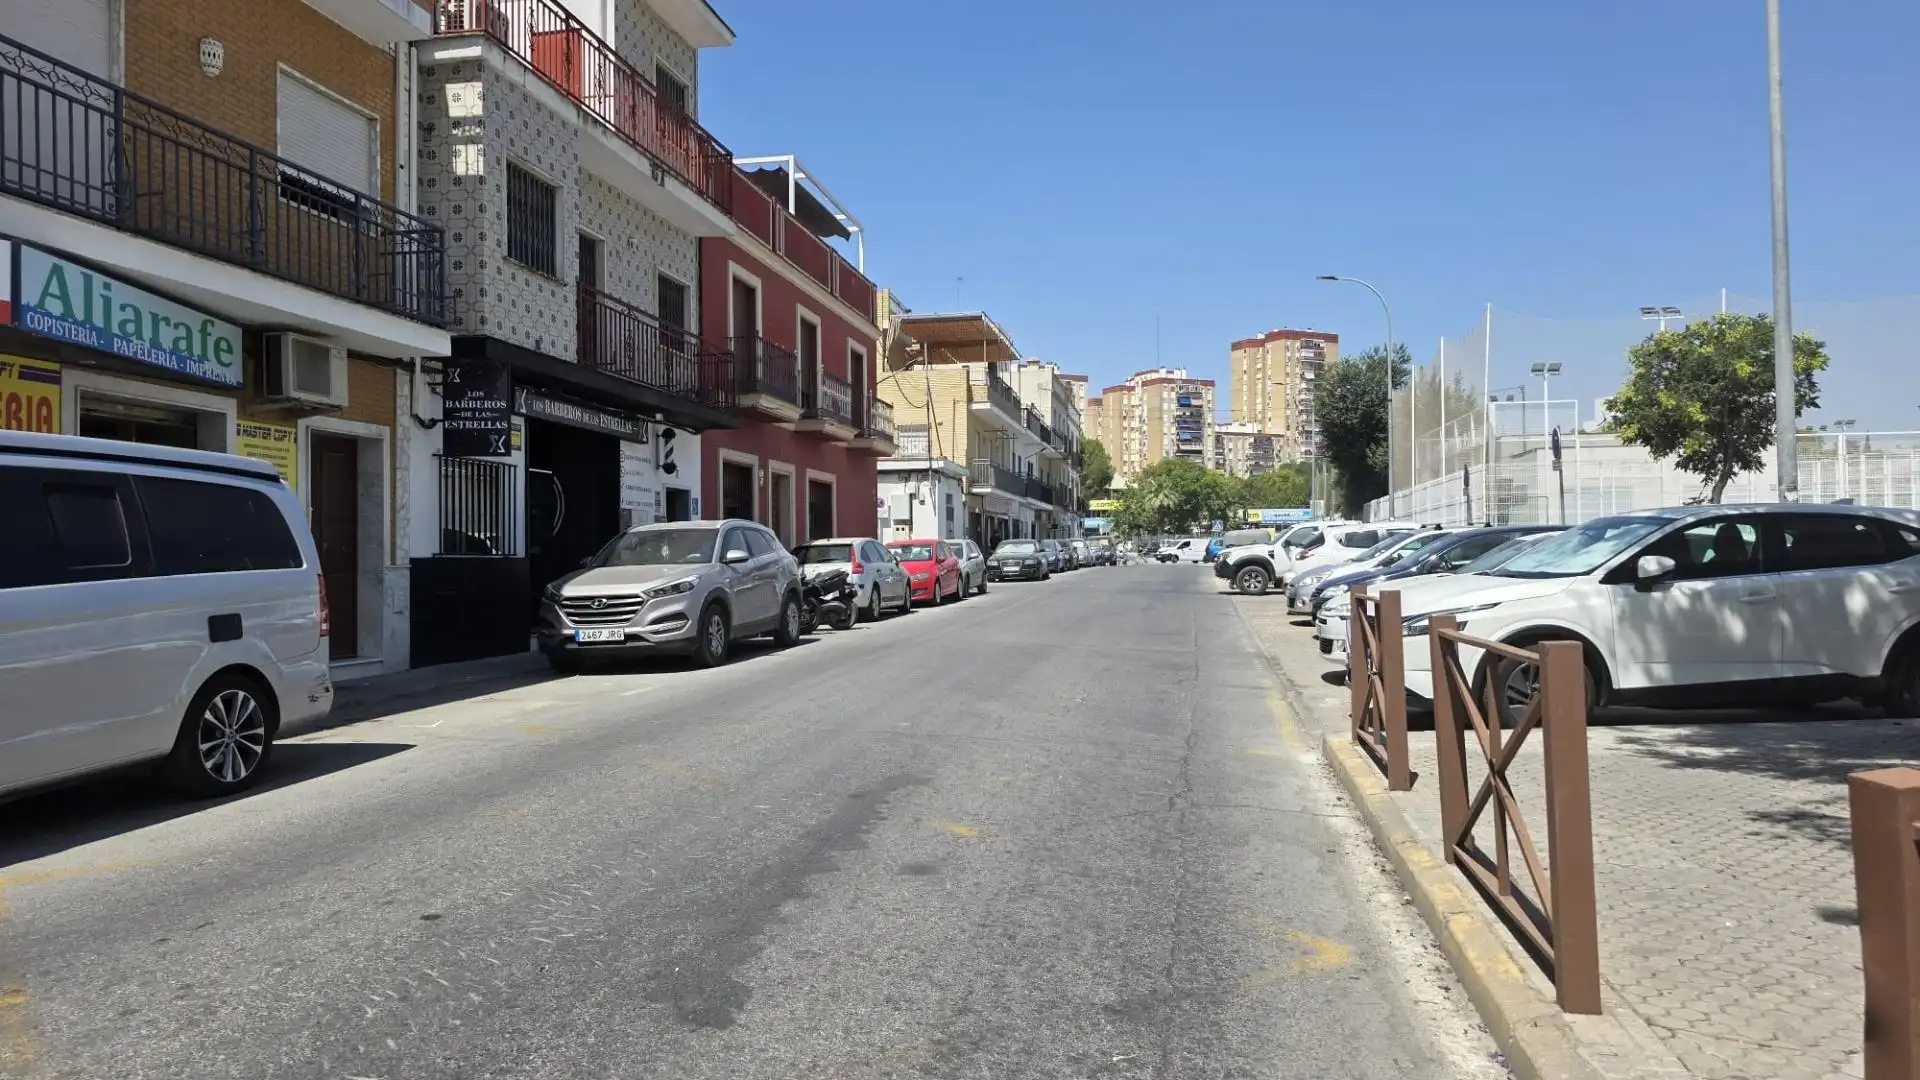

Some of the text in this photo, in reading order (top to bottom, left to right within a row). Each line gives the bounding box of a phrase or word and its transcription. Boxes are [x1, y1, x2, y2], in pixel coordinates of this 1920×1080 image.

[36, 261, 234, 369] Aliarafe
[0, 391, 53, 433] RIA
[445, 400, 507, 408] BARBEROS
[444, 420, 509, 429] ESTRELLAS
[545, 399, 582, 421] BARBEROS
[600, 412, 633, 433] ESTRELLAS
[581, 630, 622, 640] 2467 JRG
